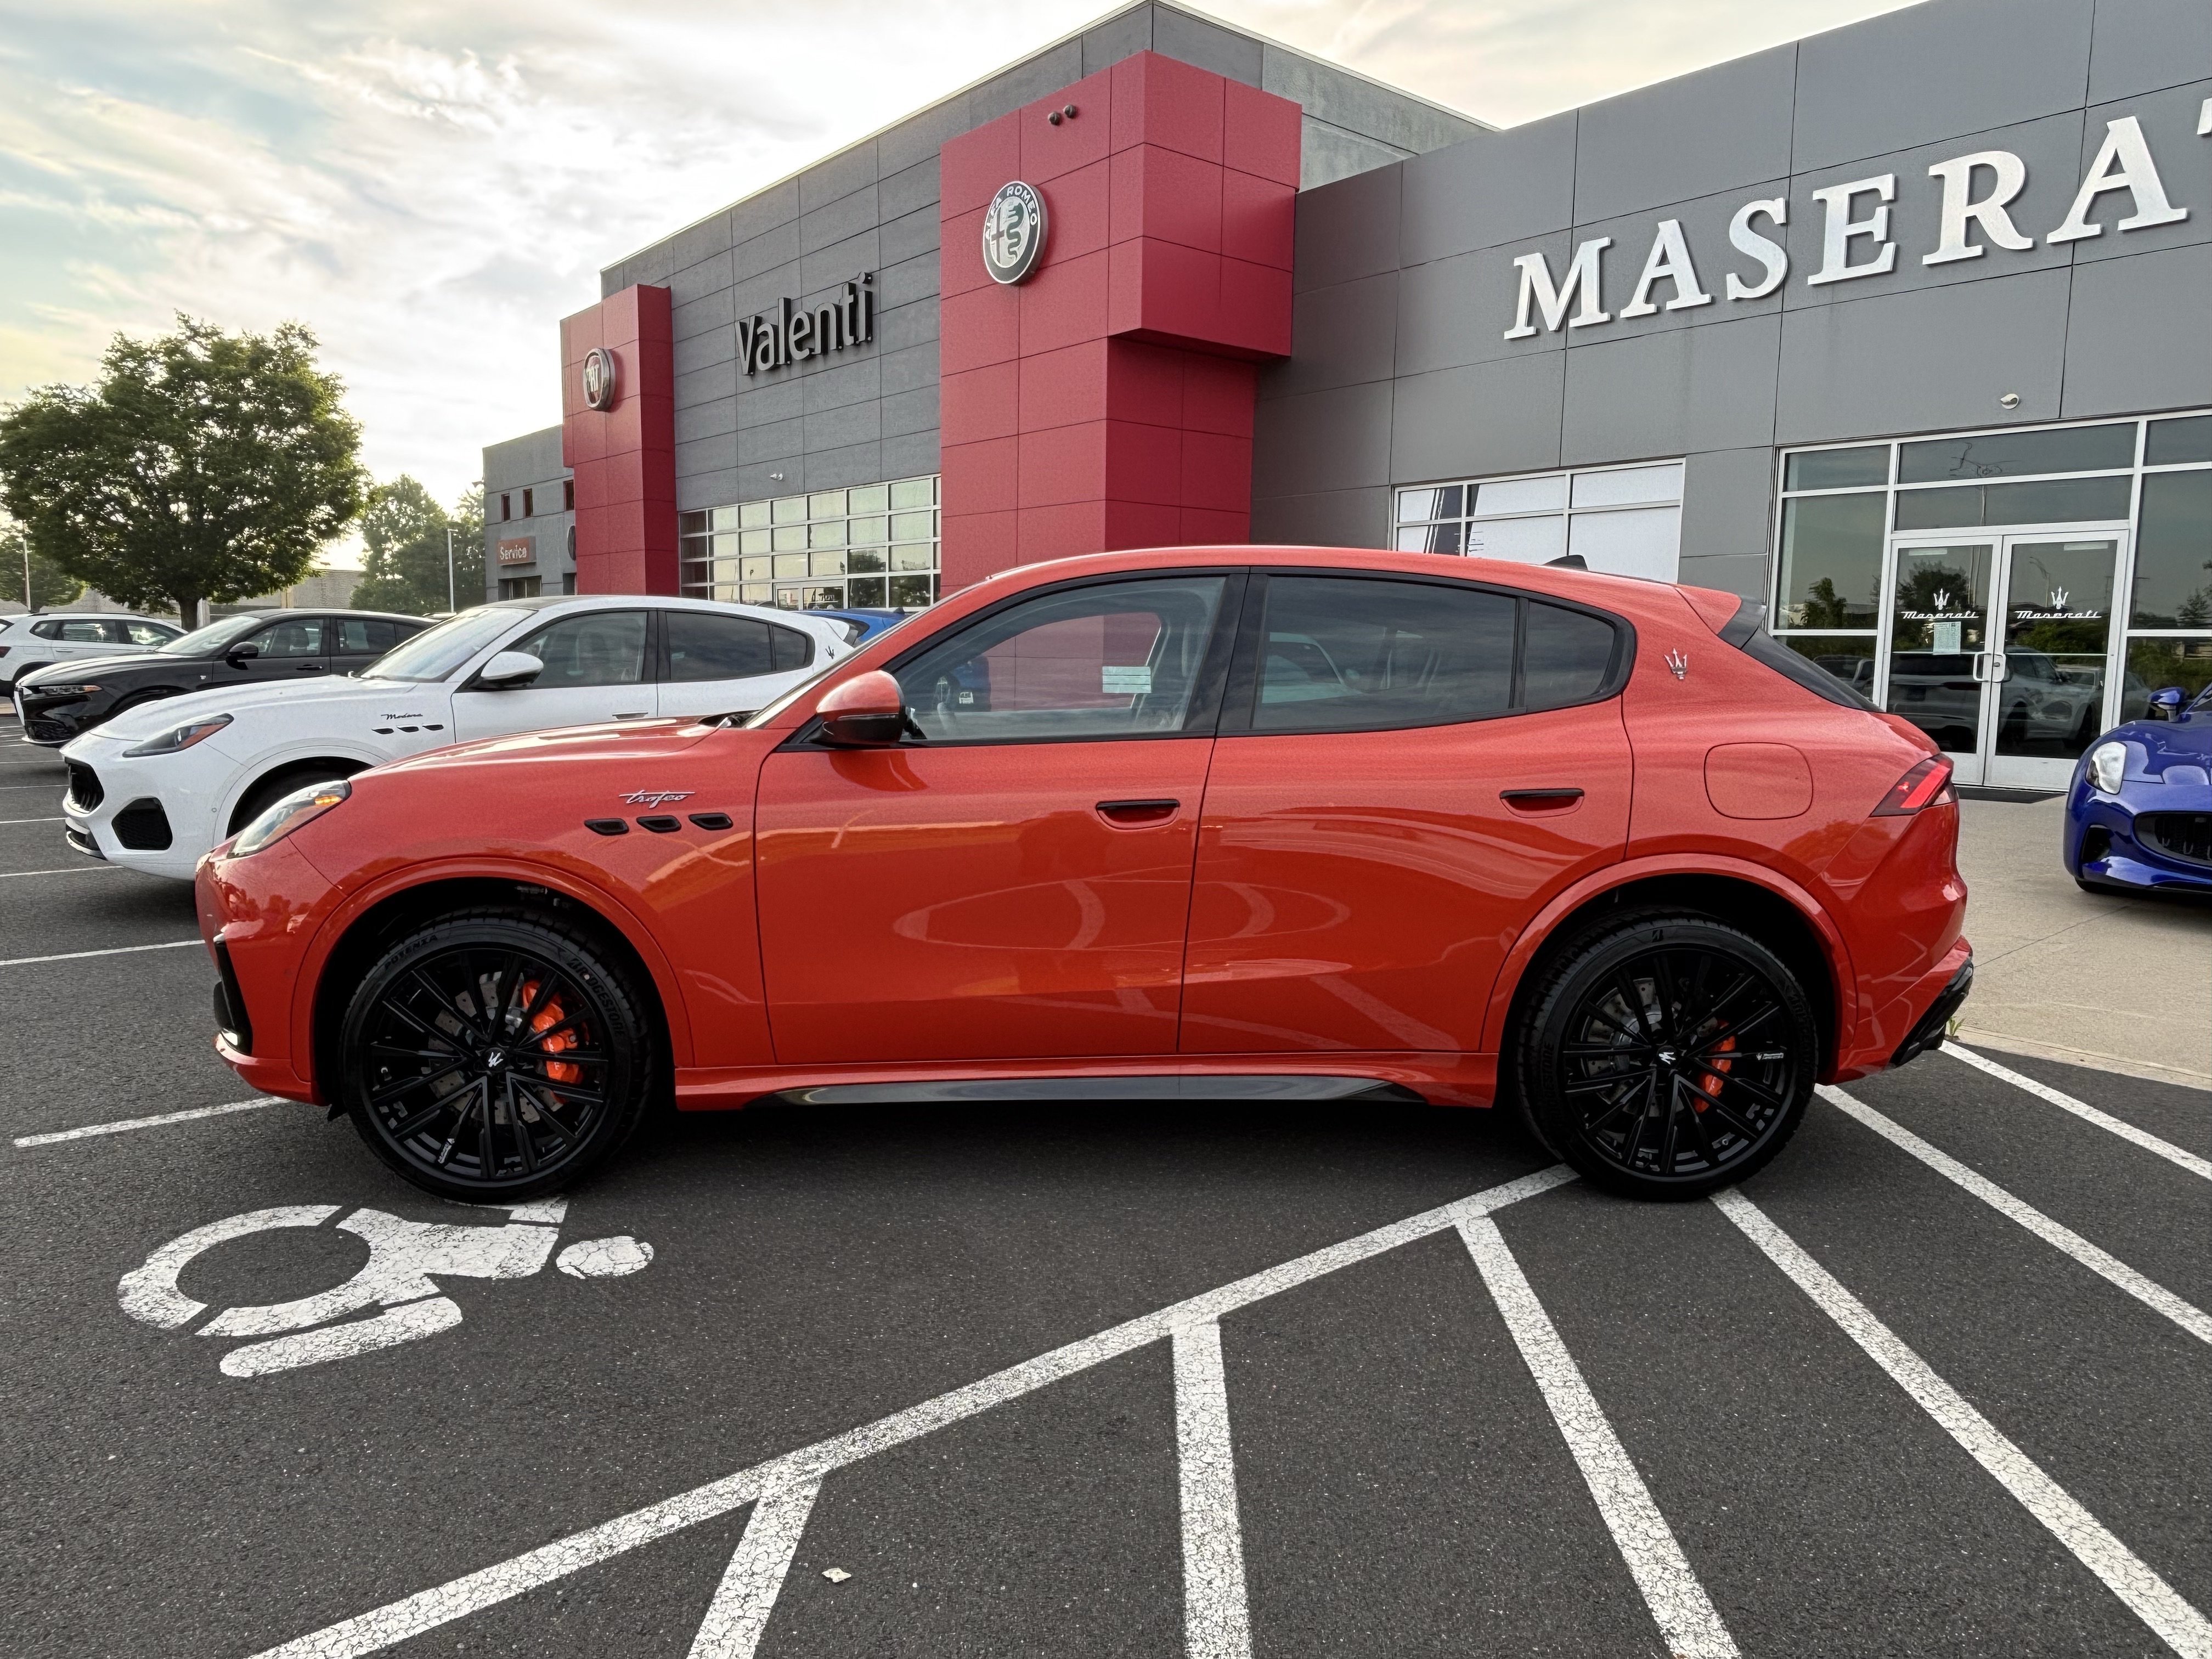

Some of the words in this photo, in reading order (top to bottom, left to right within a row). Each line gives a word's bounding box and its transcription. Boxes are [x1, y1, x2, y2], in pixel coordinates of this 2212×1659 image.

[1006, 185, 1037, 226] ROMEO
[1504, 97, 2212, 341] MASERA
[735, 271, 873, 376] Valenti
[1901, 611, 1979, 619] Maserati
[2014, 610, 2102, 619] Maserati
